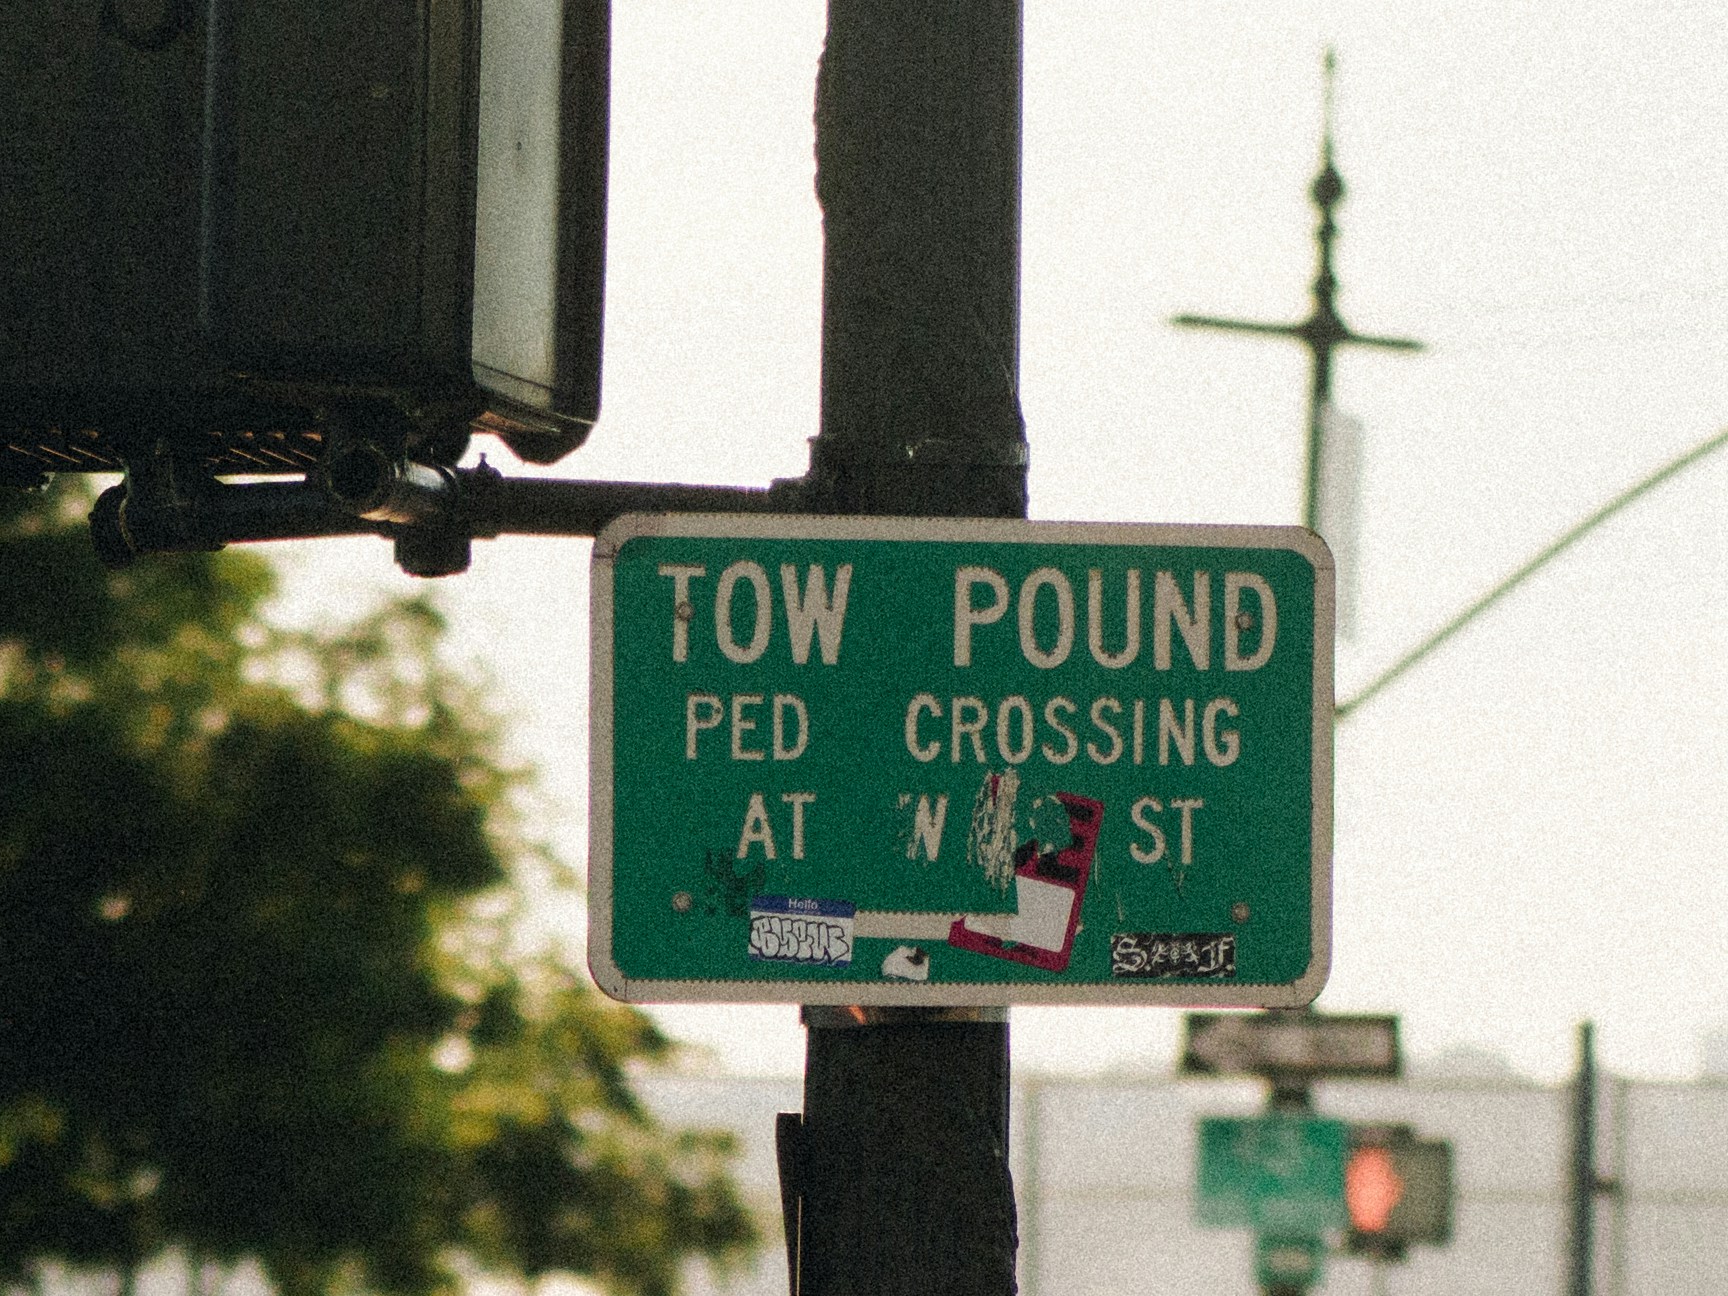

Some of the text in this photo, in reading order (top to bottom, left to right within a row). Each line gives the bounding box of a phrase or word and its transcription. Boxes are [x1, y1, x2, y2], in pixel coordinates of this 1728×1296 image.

[658, 561, 1278, 672] TOW POUND
[686, 693, 1241, 768] PED CROSSING
[736, 793, 817, 861] AT
[1130, 798, 1204, 865] ST
